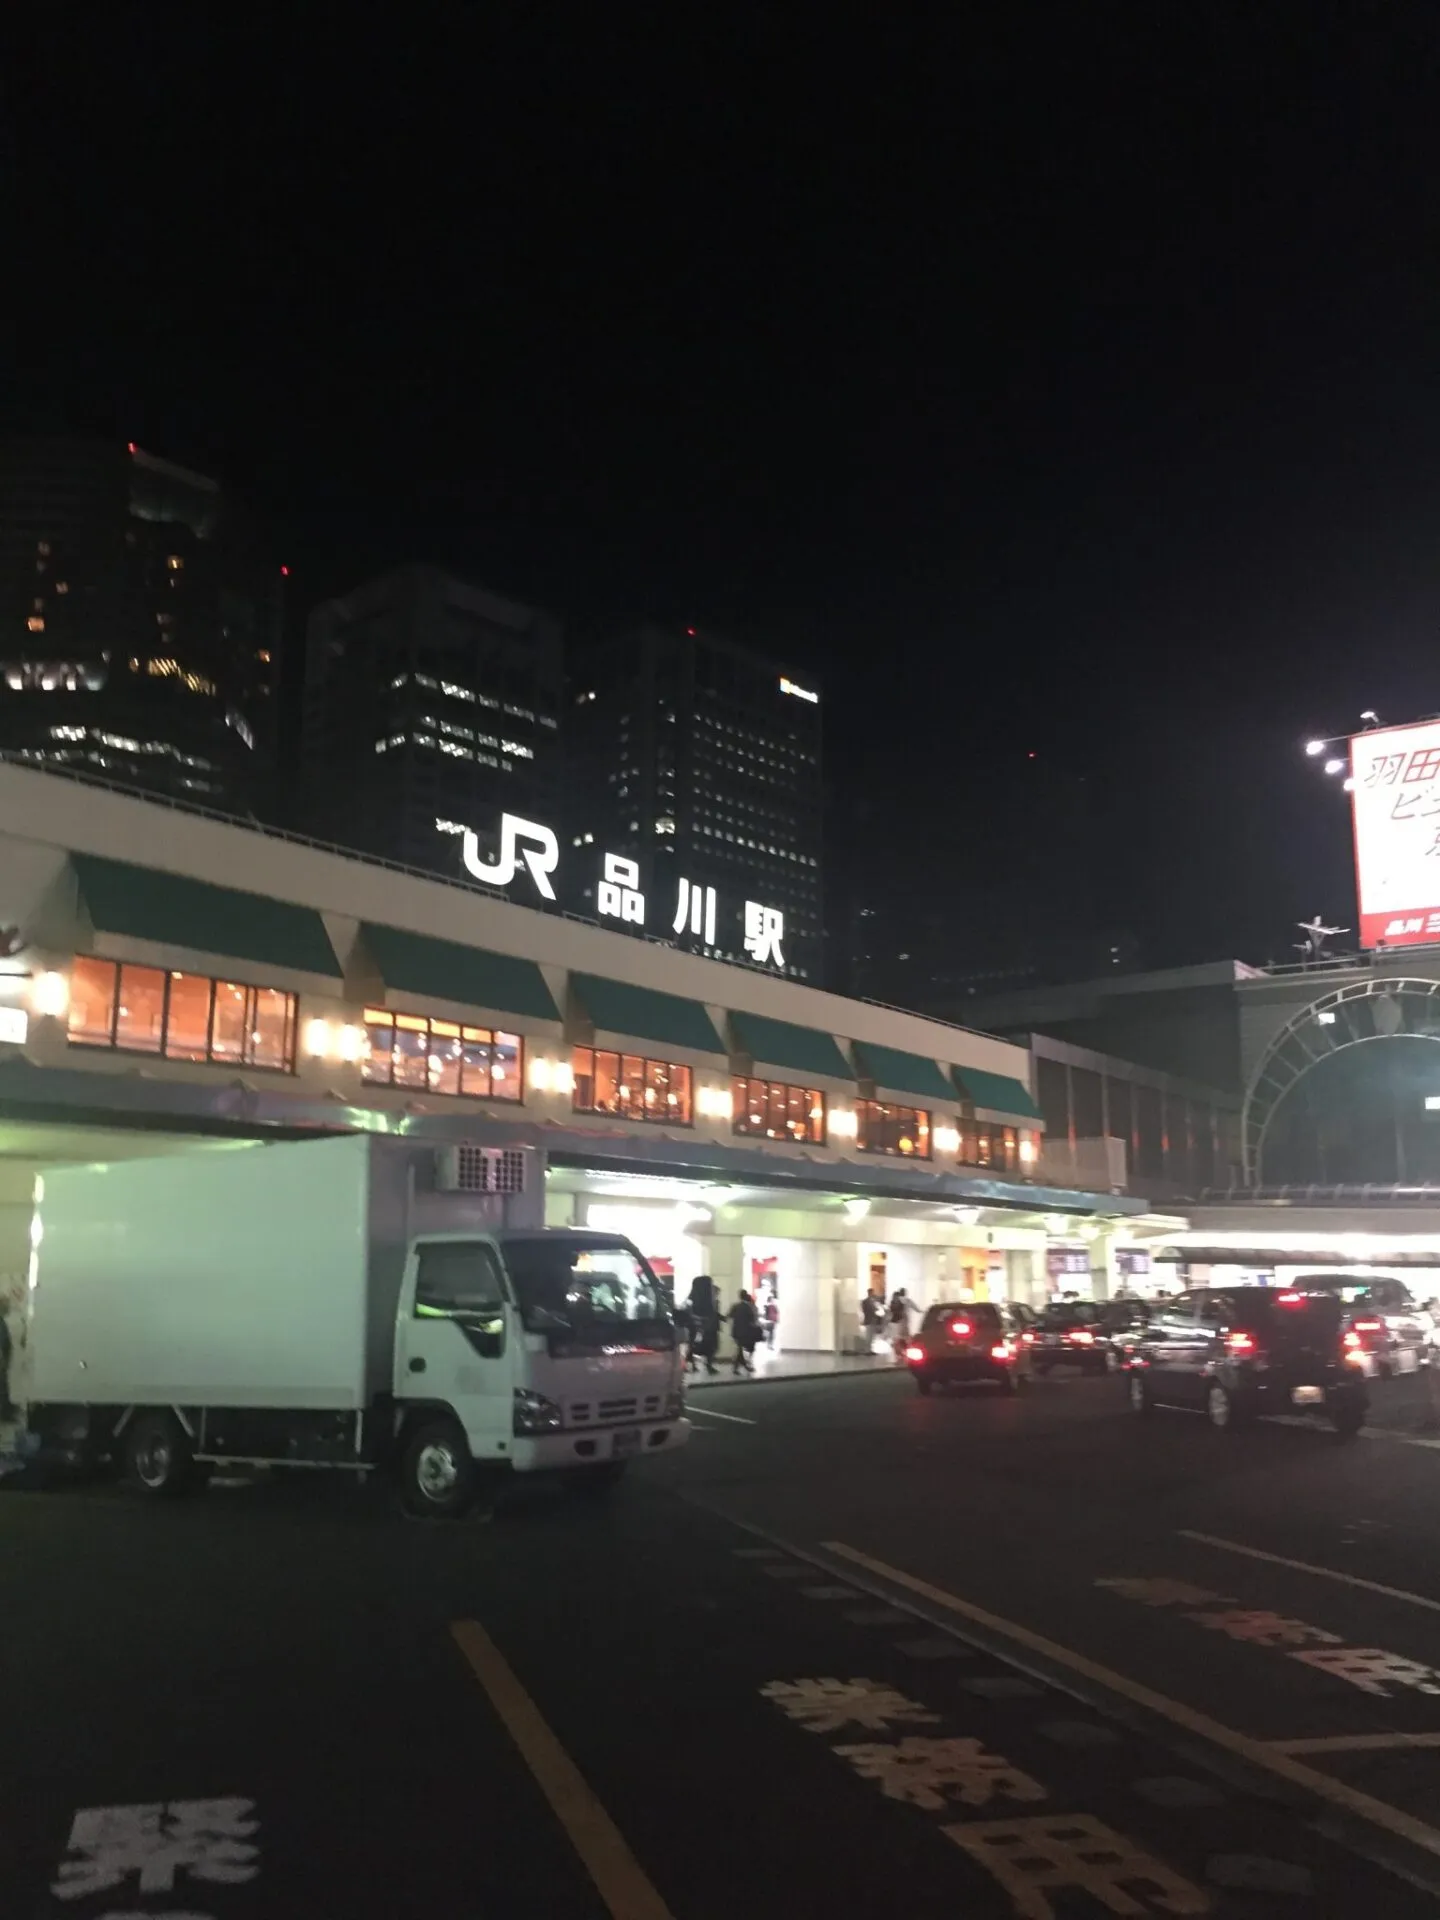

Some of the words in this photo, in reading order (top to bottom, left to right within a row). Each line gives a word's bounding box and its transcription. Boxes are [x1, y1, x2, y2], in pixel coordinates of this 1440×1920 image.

[463, 812, 559, 900] JR
[598, 852, 785, 967] 品川駅
